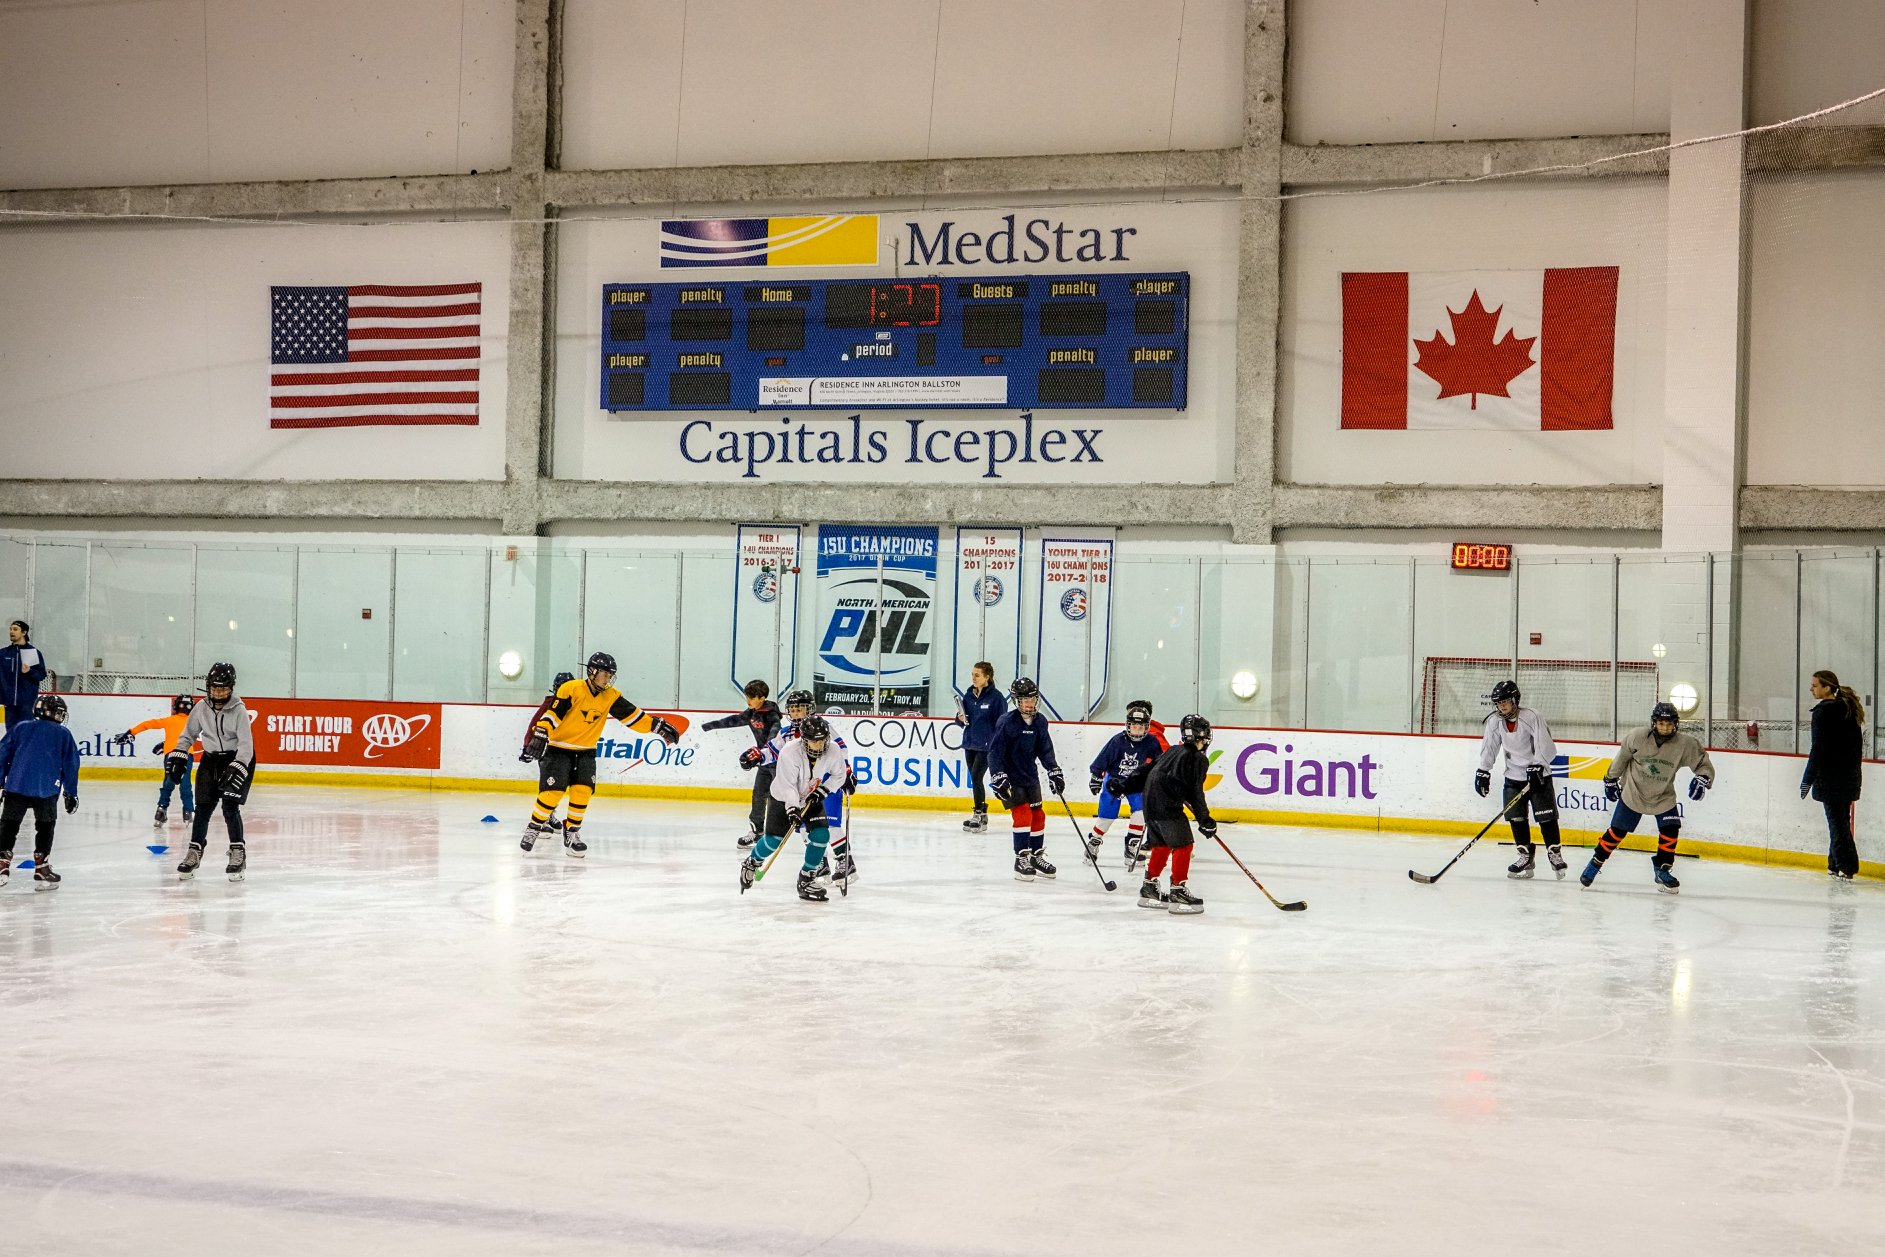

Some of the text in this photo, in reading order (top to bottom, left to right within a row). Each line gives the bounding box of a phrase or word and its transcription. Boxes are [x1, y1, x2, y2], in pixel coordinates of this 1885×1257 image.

[904, 214, 1137, 266] MedStar
[681, 287, 722, 303] penalty
[762, 287, 792, 301] Home
[973, 284, 1013, 298] Guests
[1052, 281, 1096, 296] penalty
[1136, 281, 1174, 295] player
[611, 290, 646, 303] player
[856, 343, 892, 358] period
[1050, 348, 1094, 364] penalty
[1134, 348, 1172, 363] player
[610, 354, 644, 368] player
[680, 353, 721, 368] penalty
[763, 385, 803, 393] Residence
[820, 381, 860, 389] RESIDENCE
[922, 380, 961, 388] BALLSTON
[679, 413, 1104, 478] Capitals Iceplex
[758, 534, 774, 543] TIER
[985, 537, 996, 545] 15
[823, 535, 934, 557] 15U CHAMPIONS
[963, 548, 1017, 558] CHAMPIONS
[1048, 548, 1078, 557] YOUTH
[1081, 549, 1100, 558] TIER
[1456, 545, 1508, 568] 00:00
[964, 561, 1015, 570] 201-2017
[1047, 560, 1061, 570] 16U
[1047, 572, 1107, 583] 2017-218
[837, 598, 873, 607] NORTH
[551, 700, 559, 709] 8
[825, 692, 859, 702] FEBRUARY
[860, 694, 870, 704] 20,
[870, 695, 887, 704] 217
[894, 695, 912, 706] TROY,
[913, 696, 922, 705] MI
[267, 715, 353, 734] START YOUR
[368, 715, 404, 745] AAA
[278, 734, 341, 753] JOURNEY
[1235, 742, 1378, 799] Giant
